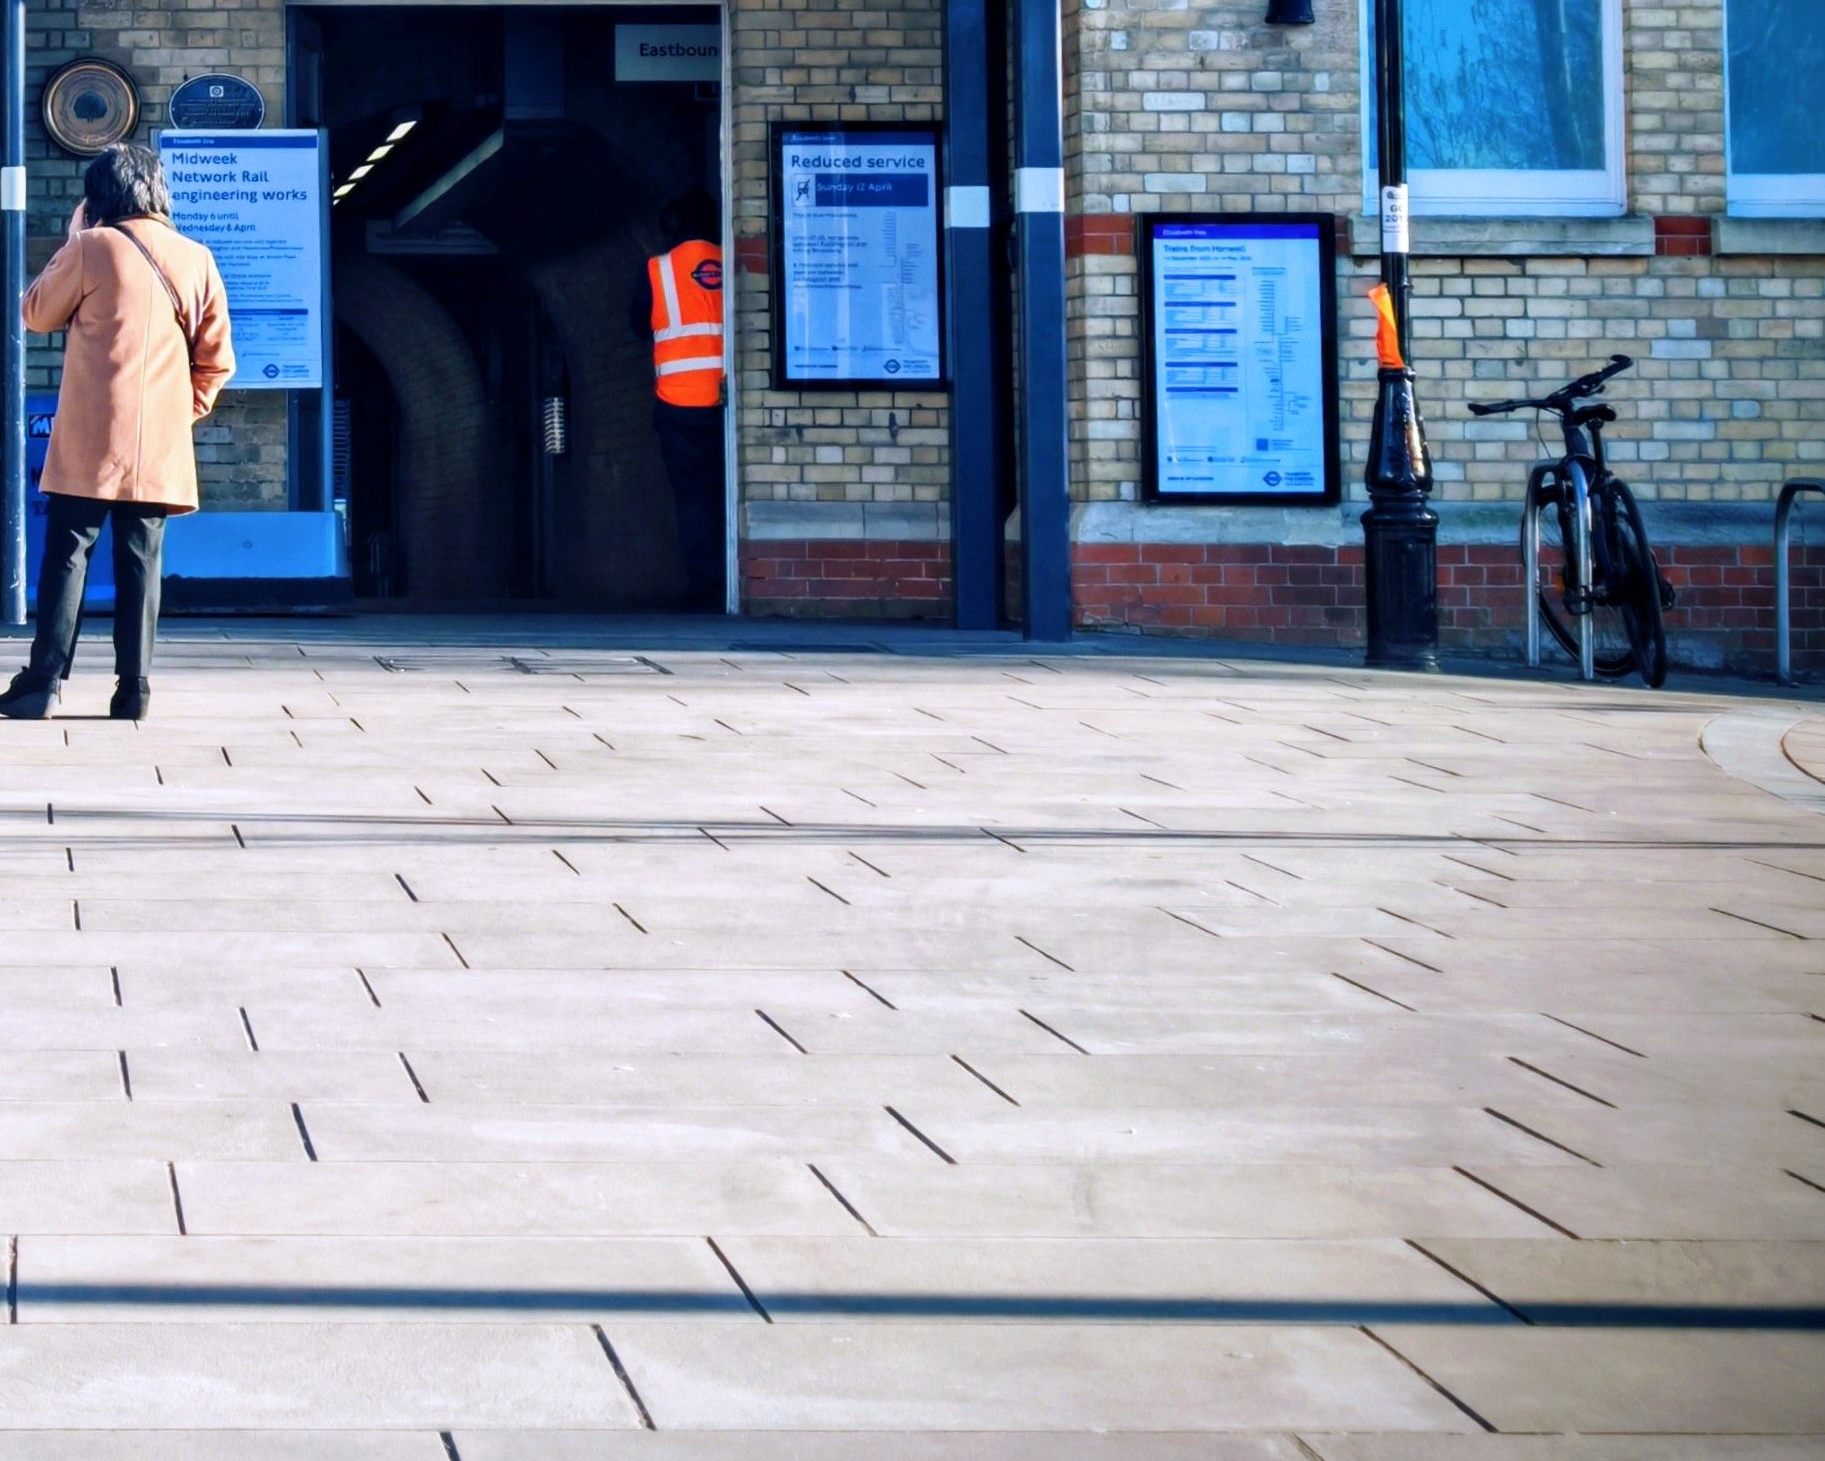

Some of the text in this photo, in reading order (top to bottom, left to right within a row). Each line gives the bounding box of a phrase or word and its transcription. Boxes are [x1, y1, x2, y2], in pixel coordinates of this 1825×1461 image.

[639, 42, 720, 57] Eastboun
[172, 153, 237, 164] Midweek
[791, 155, 925, 168] Reduced service
[172, 171, 269, 183] Network Rail
[817, 183, 892, 192] Sunday 12 April
[172, 189, 307, 203] engineering works
[173, 213, 207, 222] Monday
[234, 224, 255, 232] April
